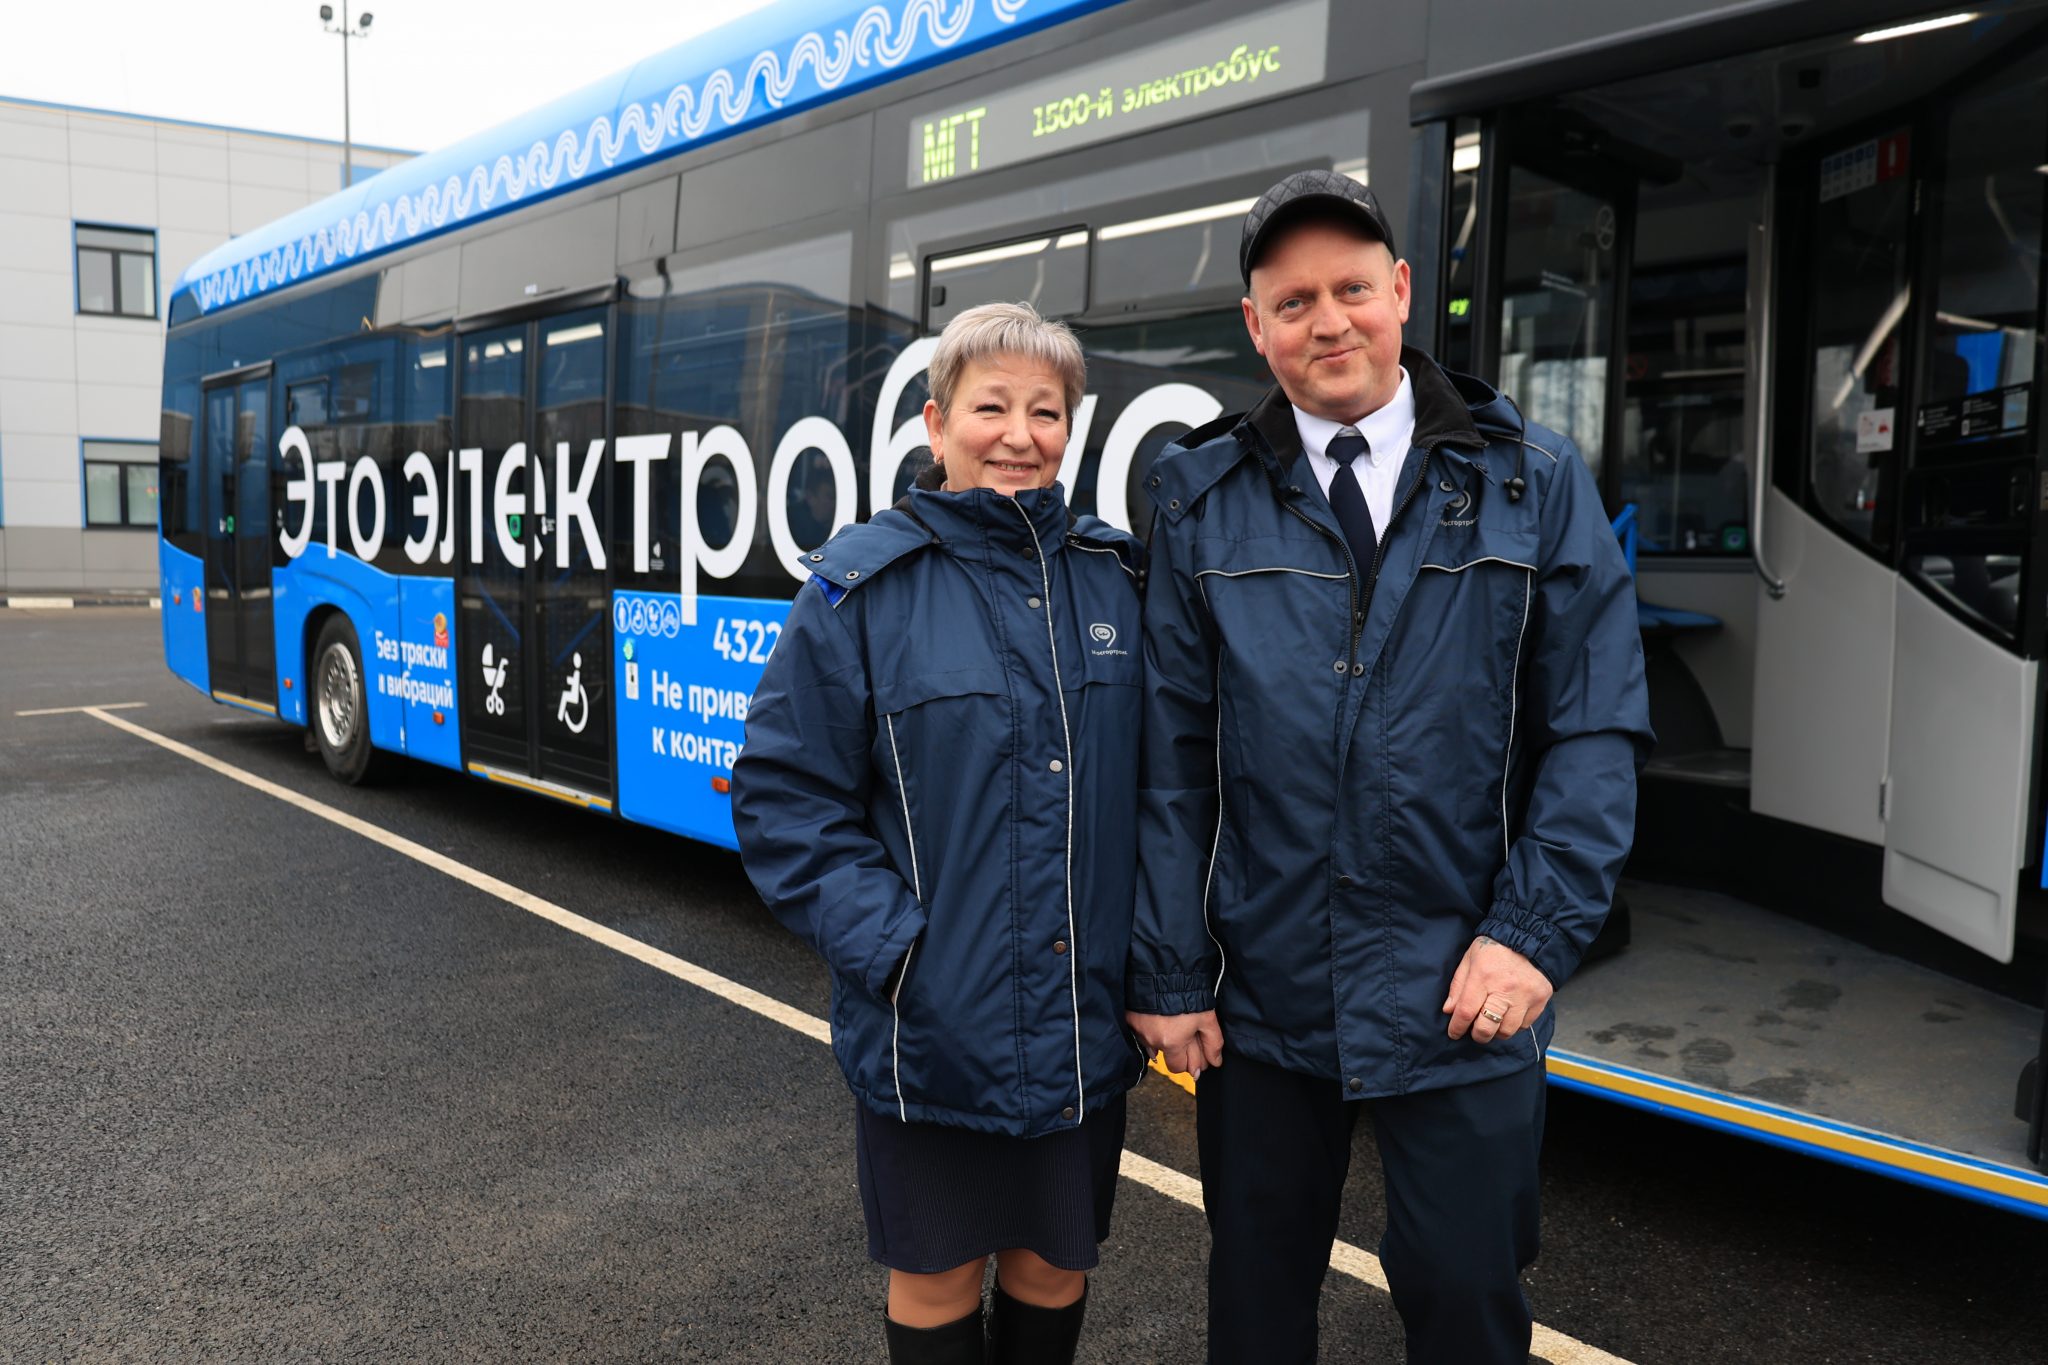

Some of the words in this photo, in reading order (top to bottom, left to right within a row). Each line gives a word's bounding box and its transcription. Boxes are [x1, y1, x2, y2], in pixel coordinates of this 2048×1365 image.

[1031, 89, 1113, 137] 1500-й
[1121, 43, 1281, 114] электробус
[922, 107, 987, 183] МГТ
[278, 425, 386, 562] Это
[400, 641, 448, 670] тряски
[386, 670, 454, 710] вибраций
[652, 669, 683, 711] Не
[688, 684, 754, 725] прив
[652, 726, 667, 757] к
